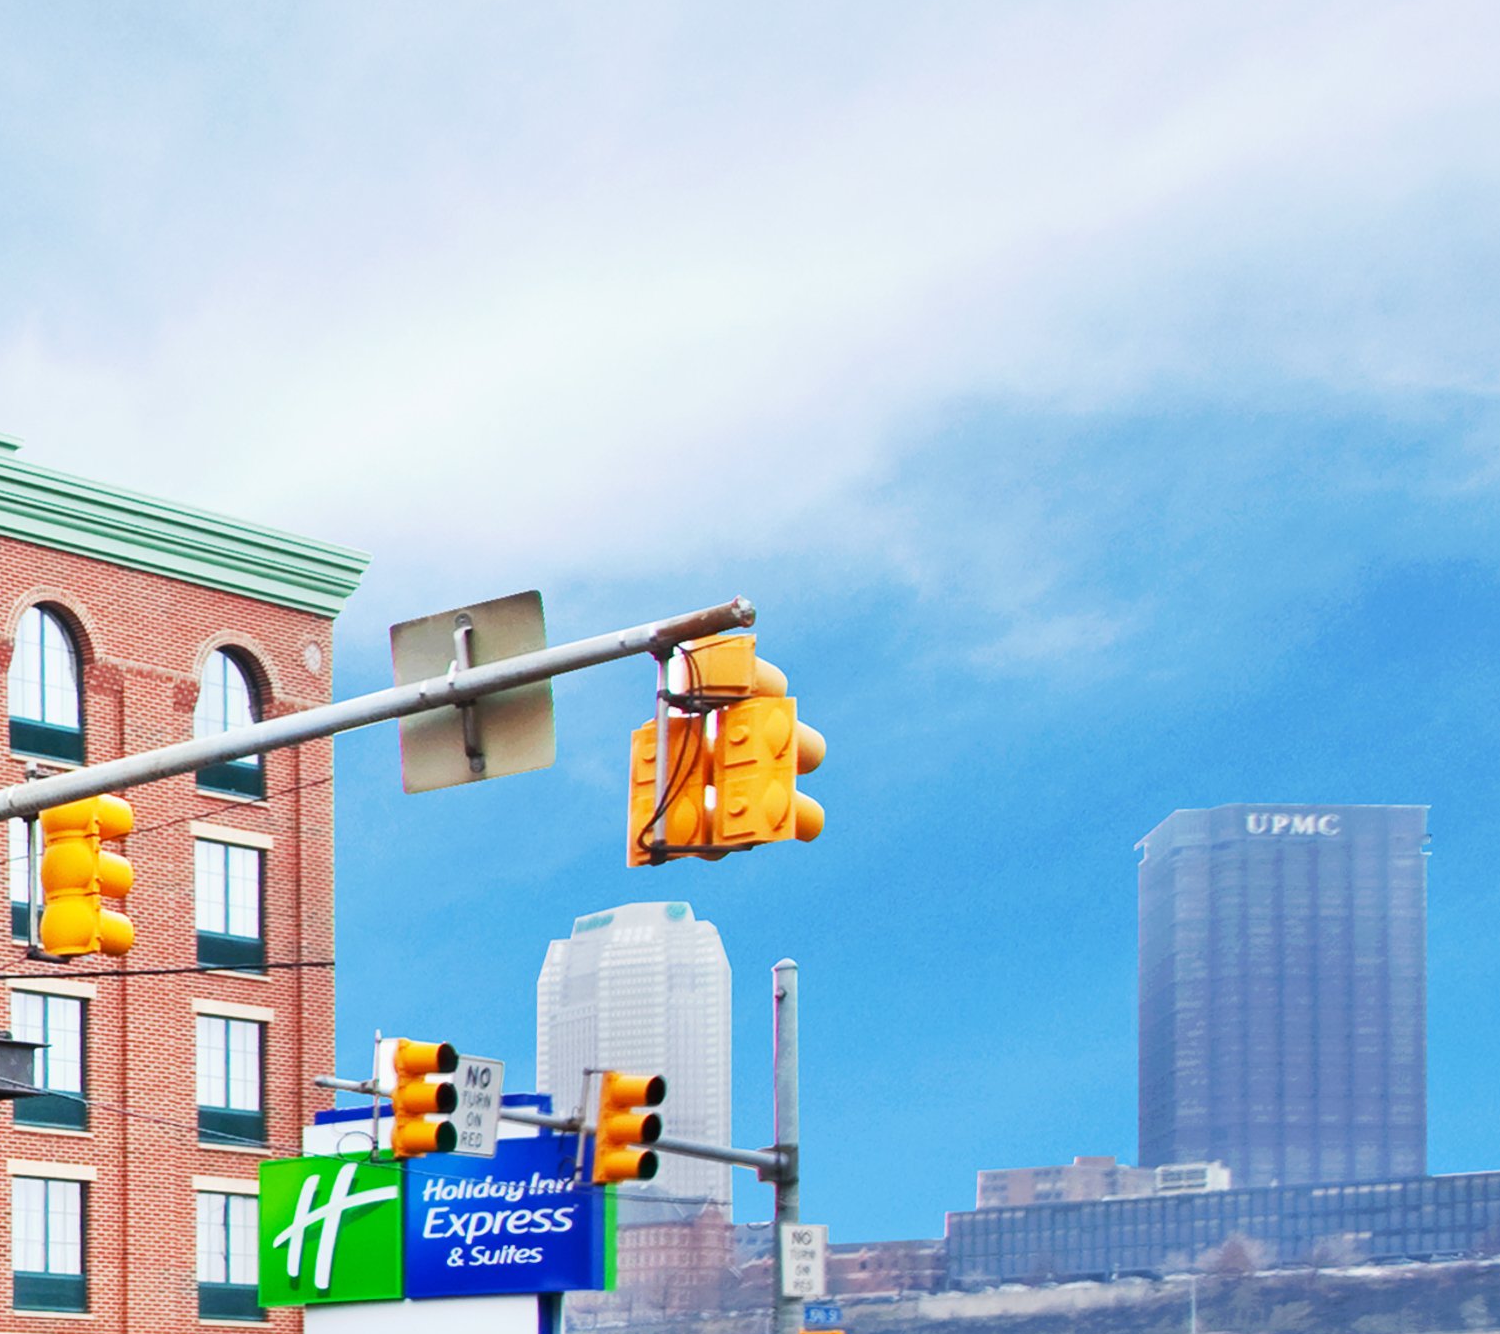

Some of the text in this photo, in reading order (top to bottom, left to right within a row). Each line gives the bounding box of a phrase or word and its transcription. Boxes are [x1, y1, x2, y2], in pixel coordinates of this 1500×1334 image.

[1245, 813, 1341, 836] UPMC
[465, 1065, 491, 1089] NO
[462, 1090, 492, 1110] TURN
[466, 1111, 483, 1128] ON
[460, 1131, 483, 1149] RED
[422, 1171, 574, 1202] Holiday Inn
[422, 1206, 575, 1245] Express
[791, 1230, 813, 1246] NO
[446, 1244, 544, 1267] & Suites
